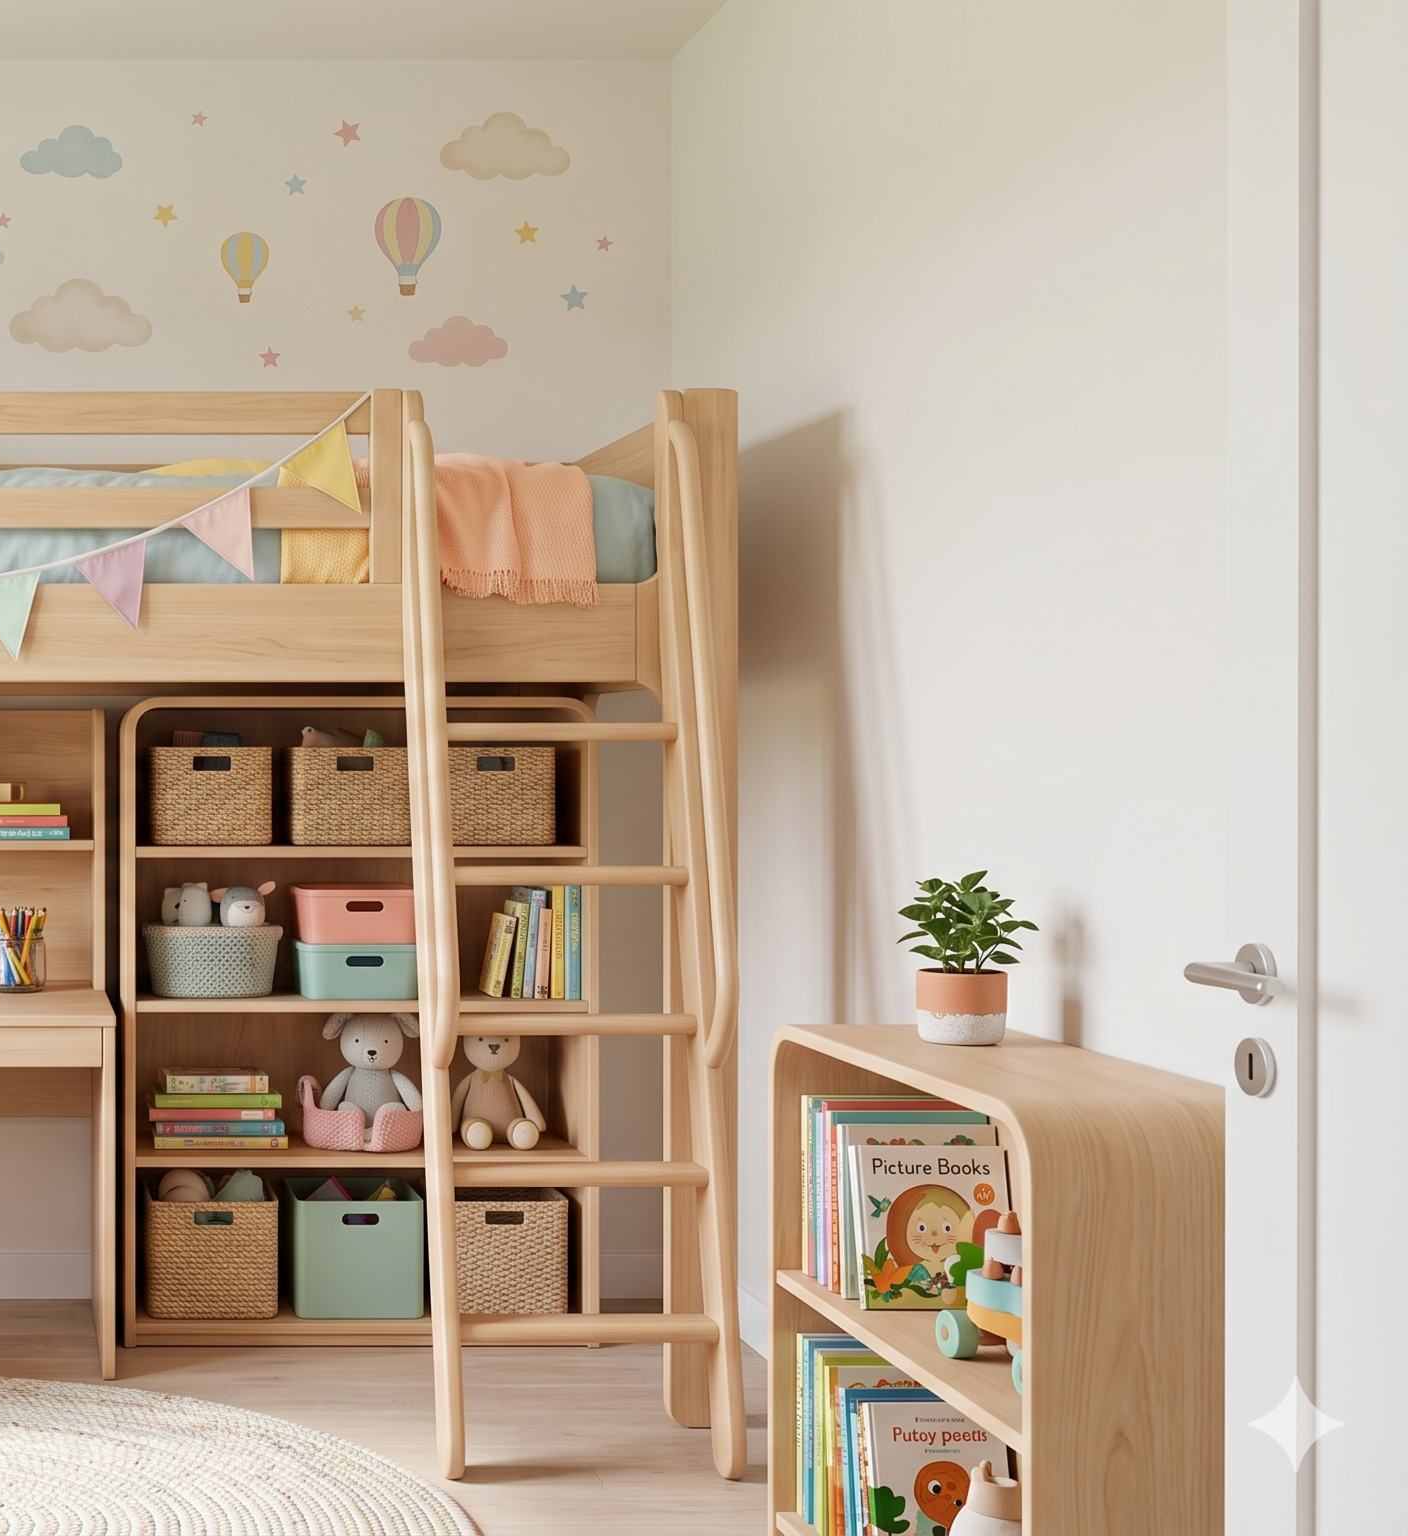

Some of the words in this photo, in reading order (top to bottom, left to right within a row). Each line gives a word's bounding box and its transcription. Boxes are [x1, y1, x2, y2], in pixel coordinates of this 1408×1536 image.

[872, 1157, 932, 1175] Picture
[938, 1158, 990, 1175] Books
[892, 1427, 936, 1446] Putoy
